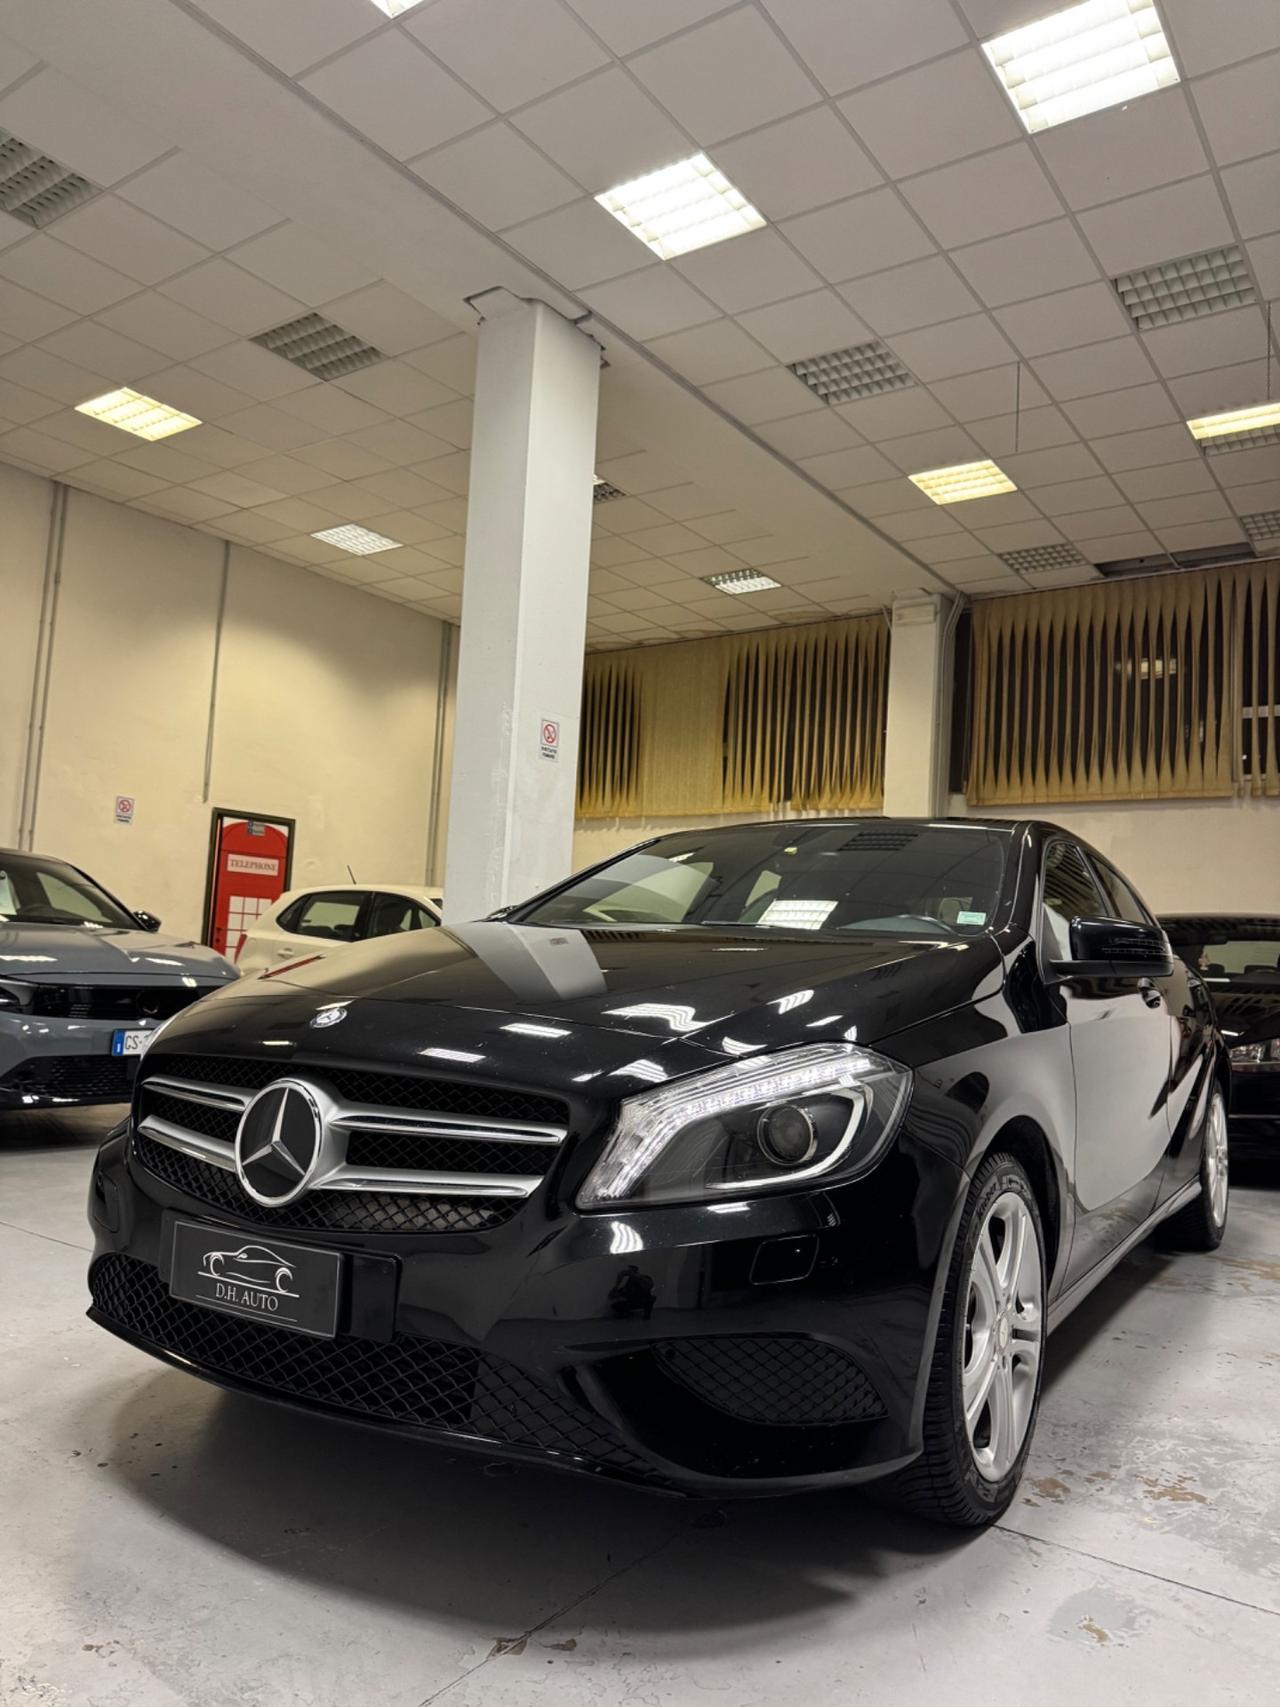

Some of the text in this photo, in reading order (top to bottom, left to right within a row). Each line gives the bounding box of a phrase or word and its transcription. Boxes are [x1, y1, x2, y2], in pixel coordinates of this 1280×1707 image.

[231, 859, 277, 871] TELEPHONE
[215, 1283, 279, 1311] D.H. AUTO
